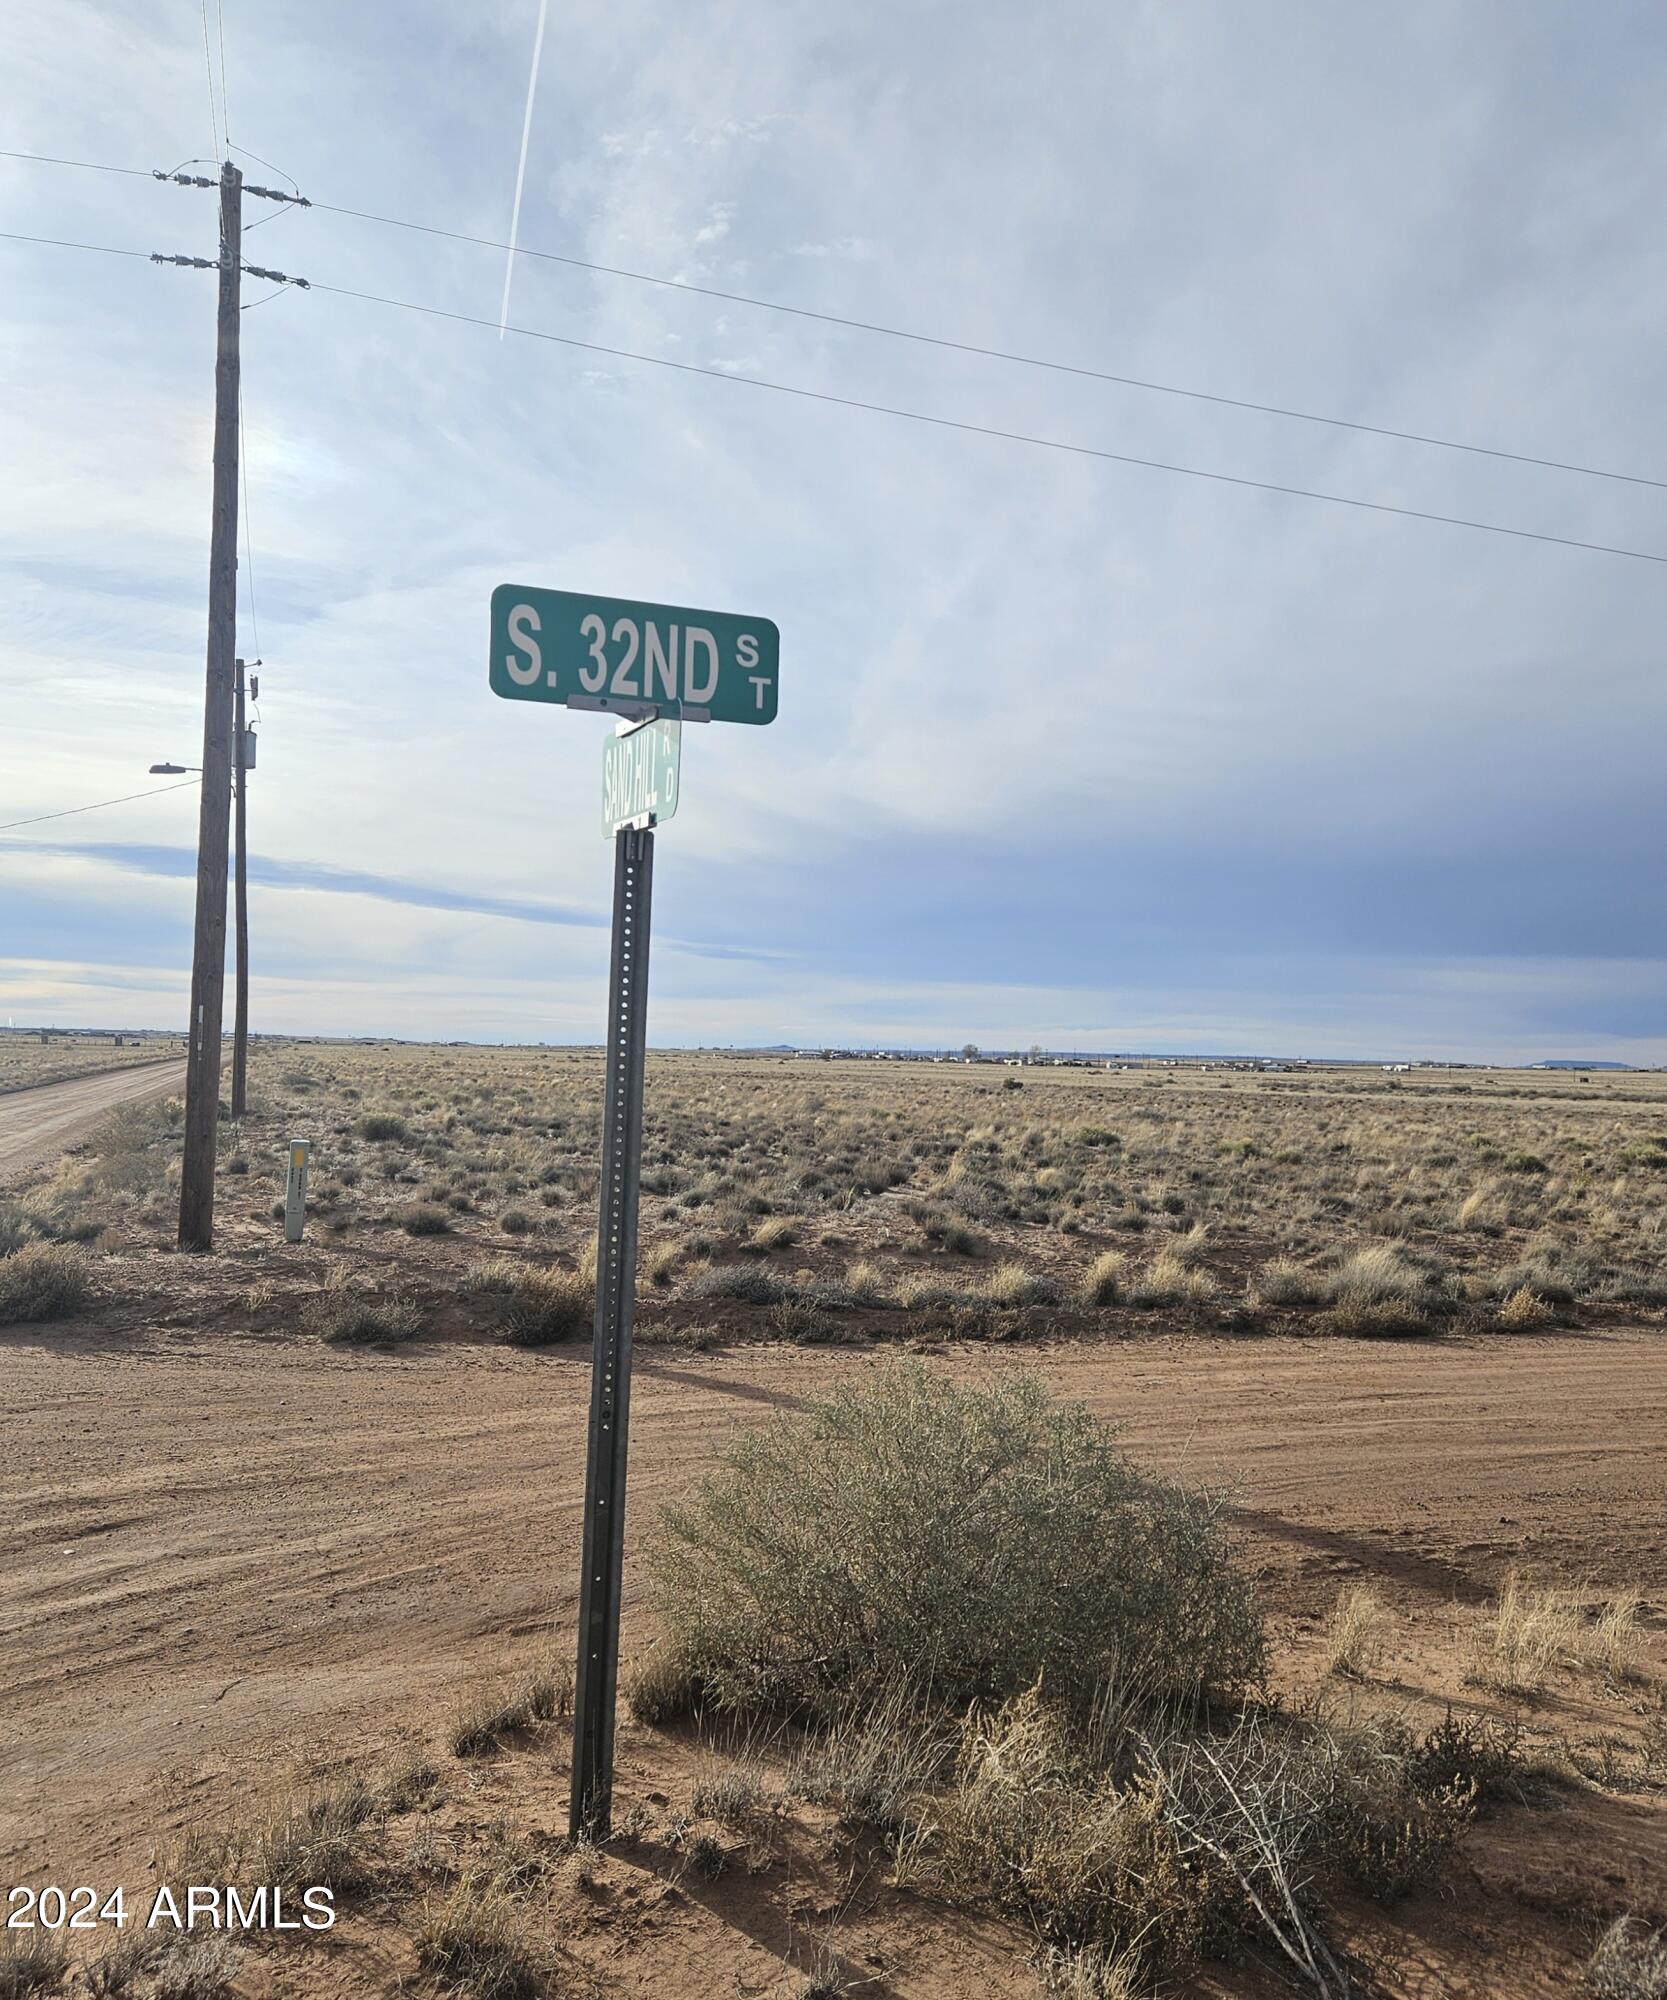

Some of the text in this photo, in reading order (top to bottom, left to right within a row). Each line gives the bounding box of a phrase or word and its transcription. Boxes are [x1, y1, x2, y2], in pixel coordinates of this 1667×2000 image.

[505, 604, 772, 709] S. 32ND ST
